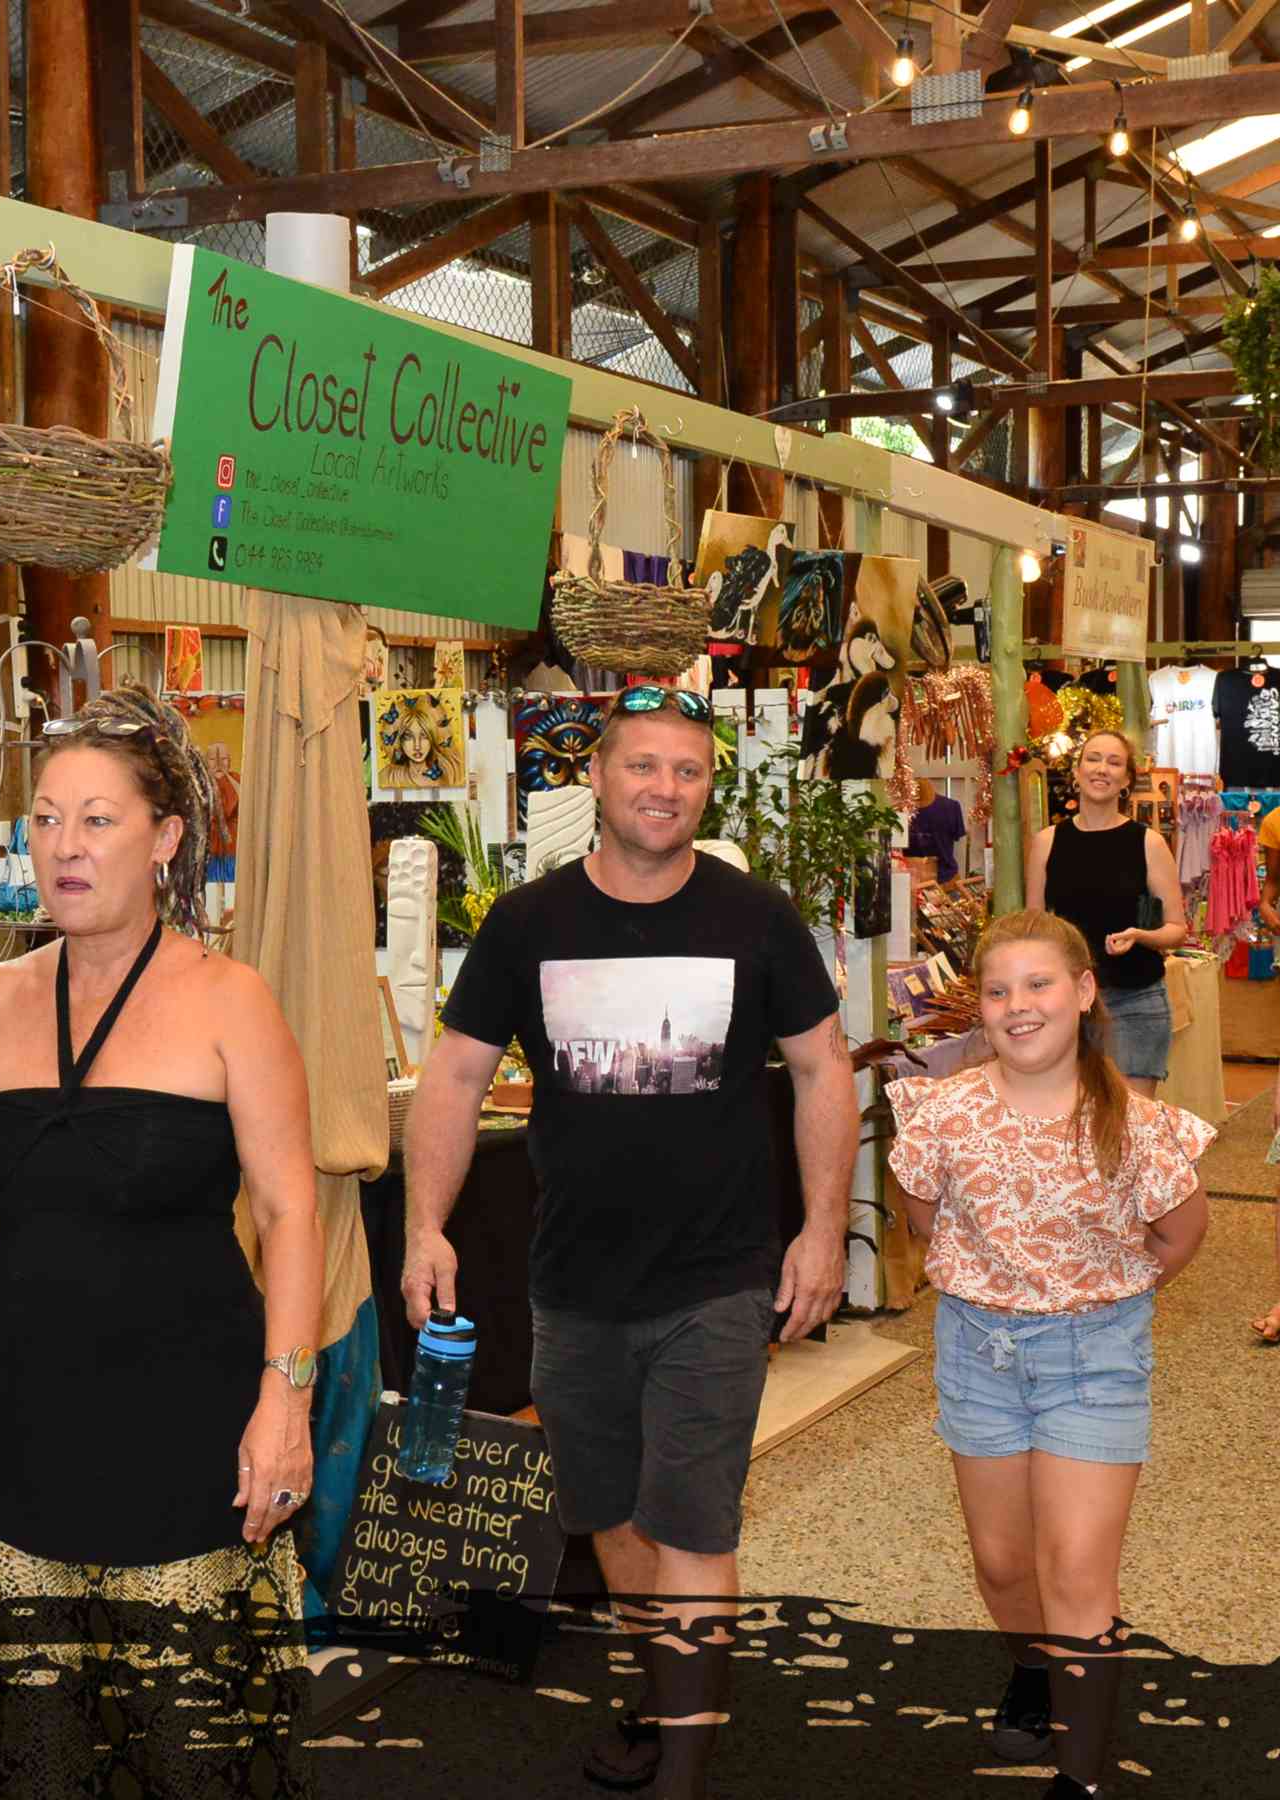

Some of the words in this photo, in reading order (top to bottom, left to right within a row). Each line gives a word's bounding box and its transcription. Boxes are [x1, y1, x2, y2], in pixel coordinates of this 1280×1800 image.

[207, 268, 250, 331] The
[249, 333, 377, 441] Closet
[390, 352, 547, 473] Collective
[311, 443, 362, 480] Local
[360, 1486, 398, 1516] the
[466, 1472, 556, 1513] matter
[345, 1554, 402, 1588] your
[354, 1520, 448, 1577] always
[462, 1541, 528, 1596] bring
